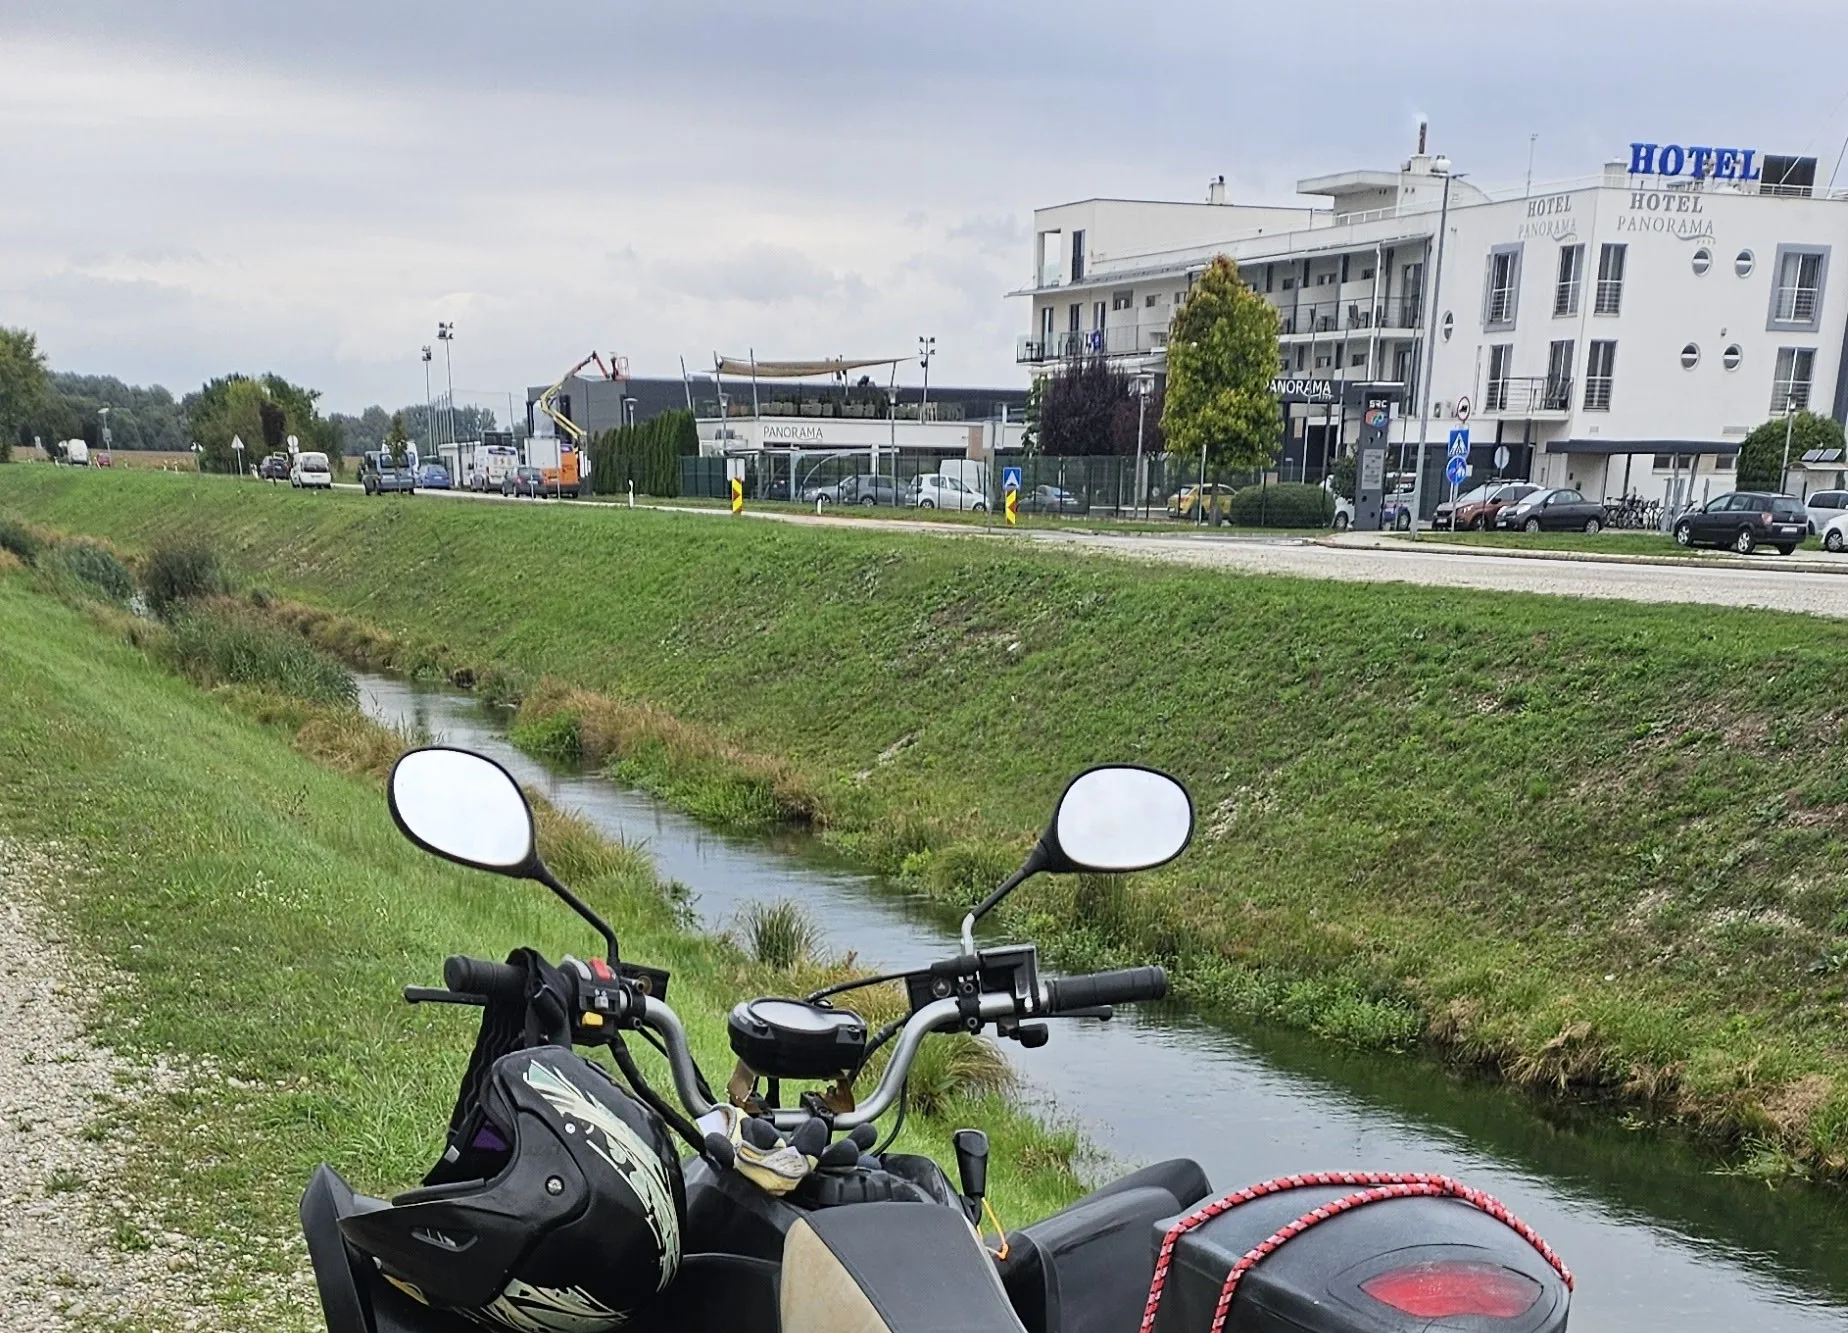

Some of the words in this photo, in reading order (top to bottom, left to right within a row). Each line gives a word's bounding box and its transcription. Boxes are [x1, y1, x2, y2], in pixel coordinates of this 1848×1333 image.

[1628, 142, 1760, 181] HOTEL
[1527, 195, 1572, 218] HOTEL
[1629, 192, 1703, 214] HOTEL
[1518, 217, 1577, 241] PANORAMA
[1616, 215, 1714, 239] PANORAMA
[763, 426, 823, 440] PANORAMA
